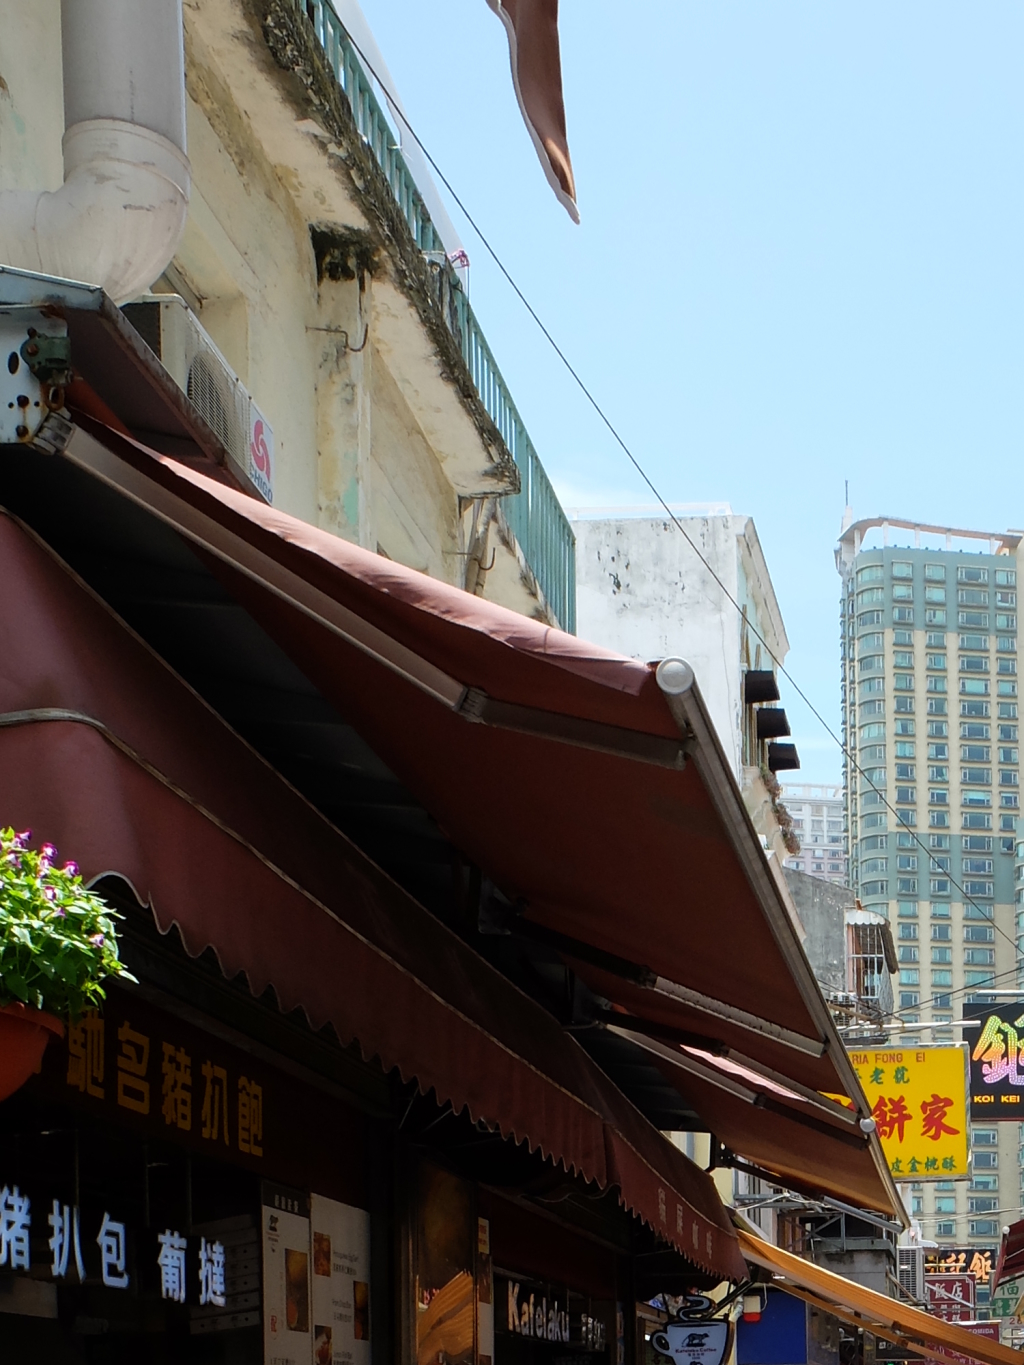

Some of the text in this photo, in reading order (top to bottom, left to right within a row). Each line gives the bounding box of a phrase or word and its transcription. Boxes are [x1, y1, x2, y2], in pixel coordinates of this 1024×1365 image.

[874, 1053, 903, 1064] FONG
[974, 1094, 994, 1104] KOI
[1001, 1094, 1020, 1104] KEI
[507, 1278, 570, 1344] Kafelaku
